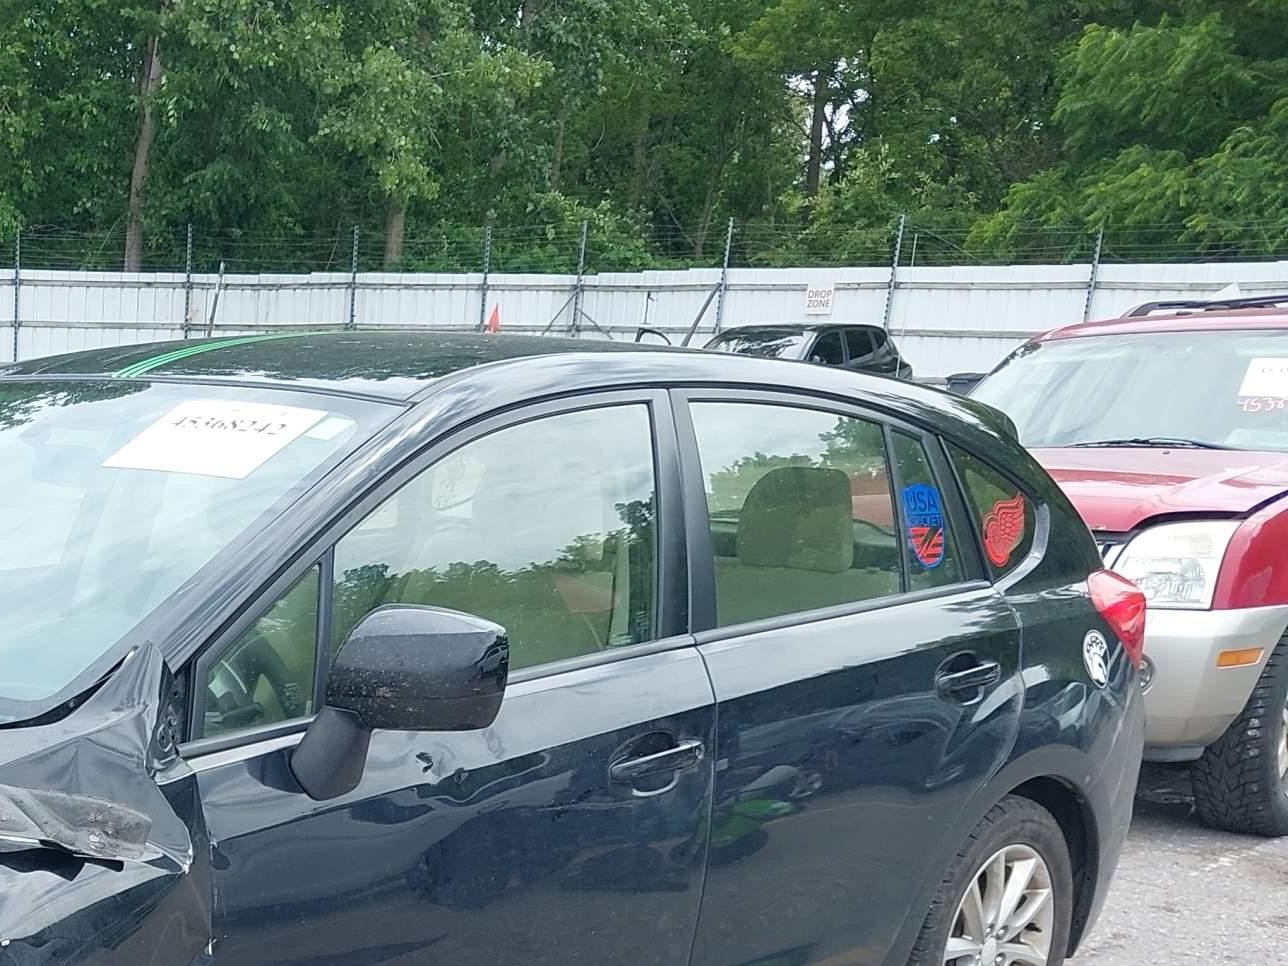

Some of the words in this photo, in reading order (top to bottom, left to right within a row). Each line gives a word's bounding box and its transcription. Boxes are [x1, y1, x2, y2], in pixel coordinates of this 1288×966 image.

[807, 289, 832, 299] DROP
[807, 299, 830, 309] ZONE
[904, 490, 938, 512] USA
